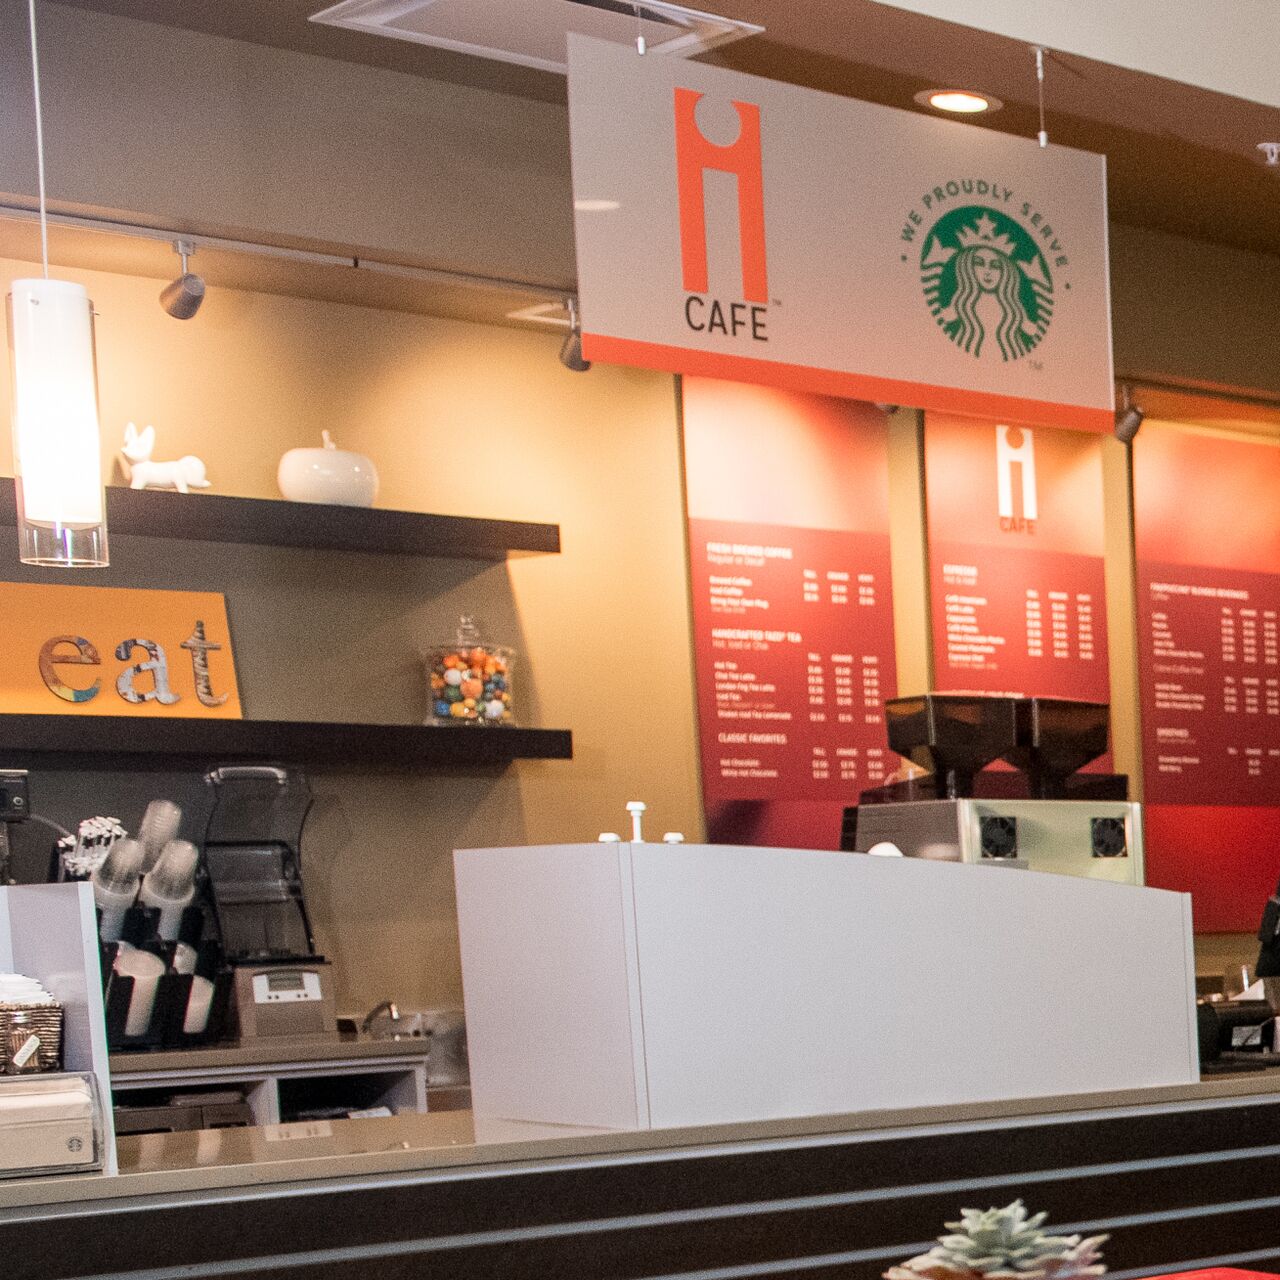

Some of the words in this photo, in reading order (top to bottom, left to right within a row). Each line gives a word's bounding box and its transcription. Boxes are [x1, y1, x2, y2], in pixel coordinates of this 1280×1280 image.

[902, 210, 922, 242] WE
[922, 179, 1014, 209] PROUDLY
[1021, 202, 1069, 267] SERVE
[685, 295, 769, 342] CAFE
[38, 620, 228, 707] eat
